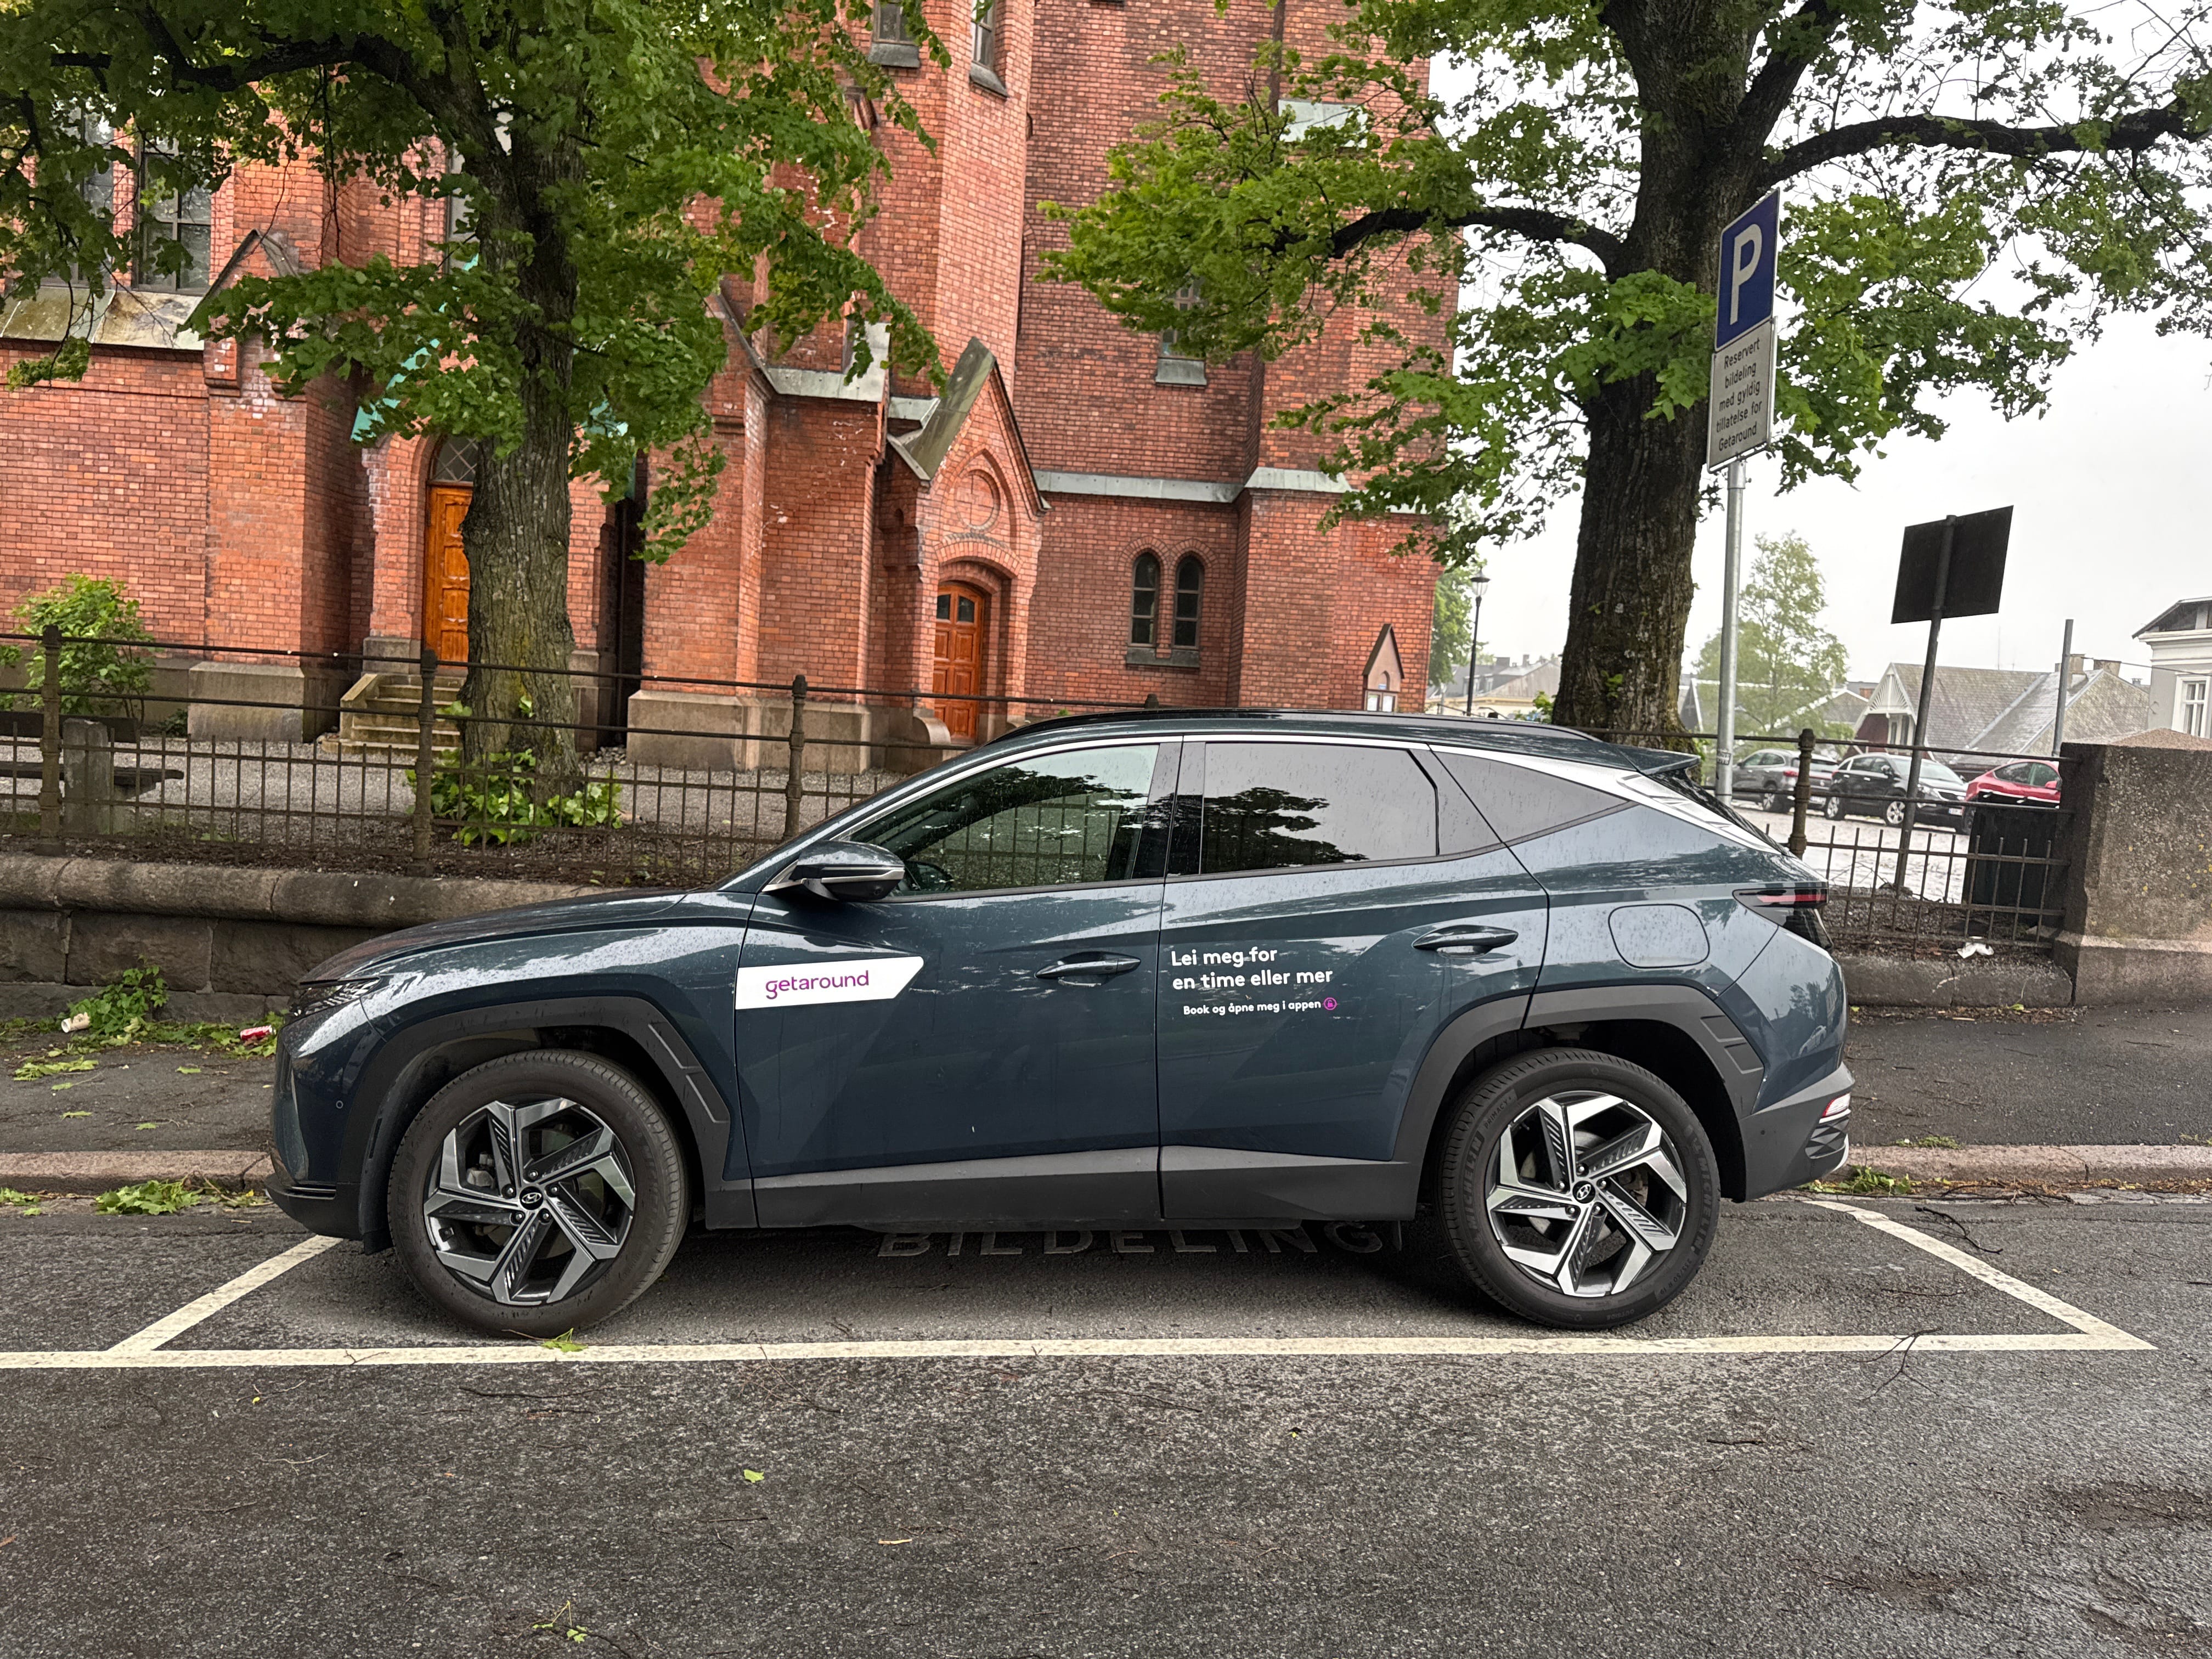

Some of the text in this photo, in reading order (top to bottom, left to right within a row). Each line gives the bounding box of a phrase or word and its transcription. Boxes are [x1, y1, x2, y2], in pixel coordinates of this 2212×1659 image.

[1729, 223, 1763, 326] P
[1724, 338, 1760, 369] Reservert
[1725, 362, 1757, 389] bildeling
[1719, 381, 1760, 411] med gyldig
[1716, 400, 1762, 433] tillatelse for
[1718, 421, 1757, 452] Getaround
[1171, 946, 1278, 968] Lei meg for
[765, 970, 870, 1000] getaround
[1172, 969, 1333, 990] en time eller mer
[1183, 1001, 1322, 1015] Book og åpne meg i appen
[1484, 1098, 1508, 1129] PRIMACY
